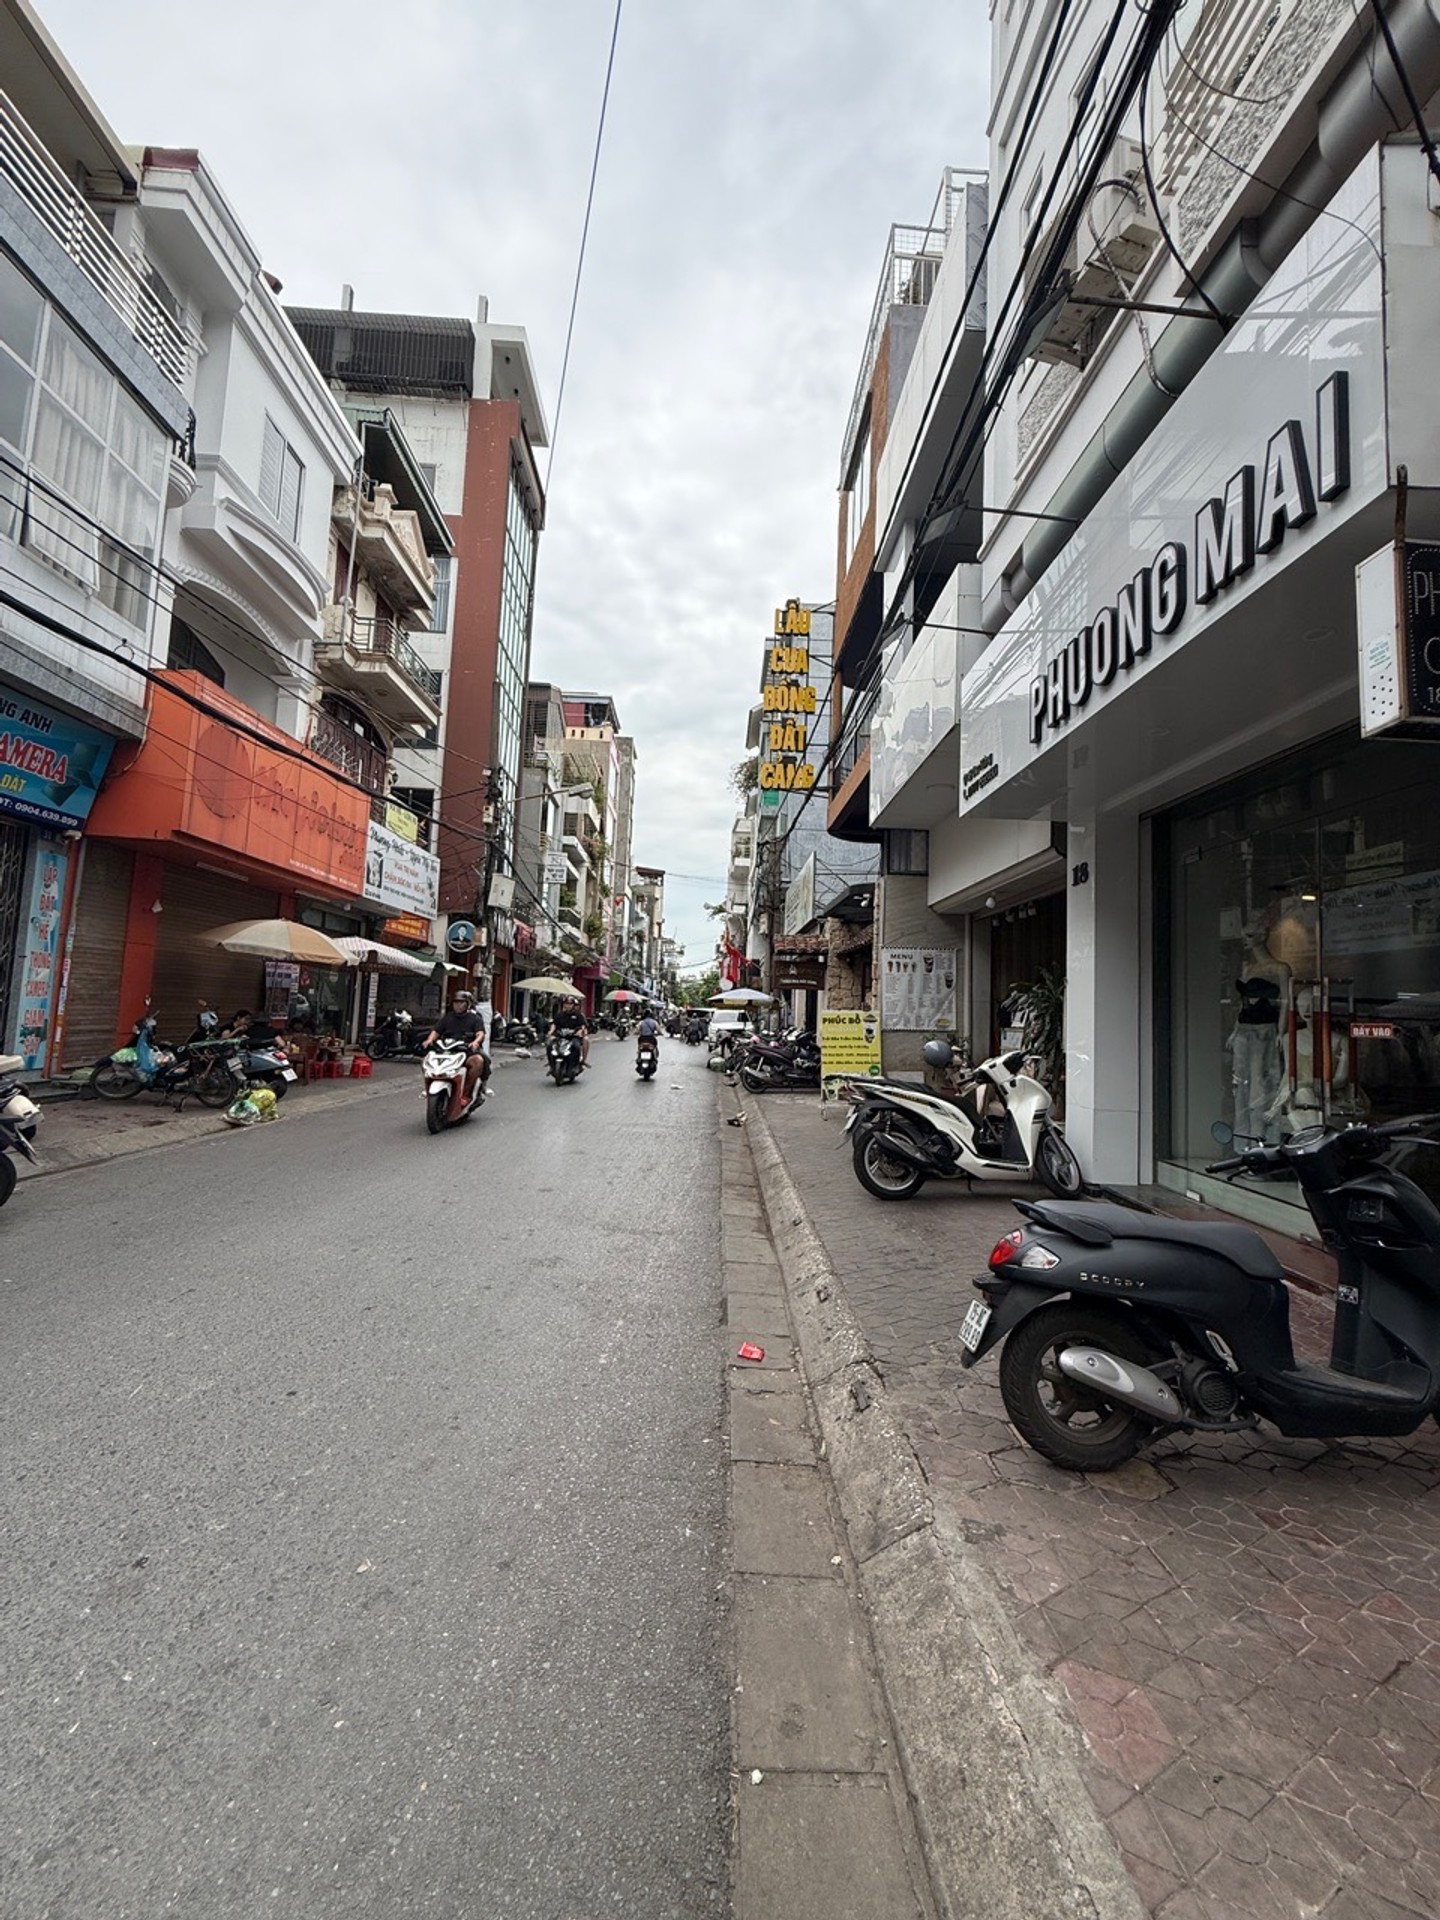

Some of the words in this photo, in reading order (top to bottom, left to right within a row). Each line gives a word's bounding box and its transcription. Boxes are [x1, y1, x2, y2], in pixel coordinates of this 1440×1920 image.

[1029, 541, 1187, 743] PHUONG
[1195, 370, 1350, 606] MAI
[771, 647, 808, 674] CUA
[18, 708, 53, 734] ANH
[1071, 861, 1089, 887] 18
[822, 1014, 847, 1024] PHÚC
